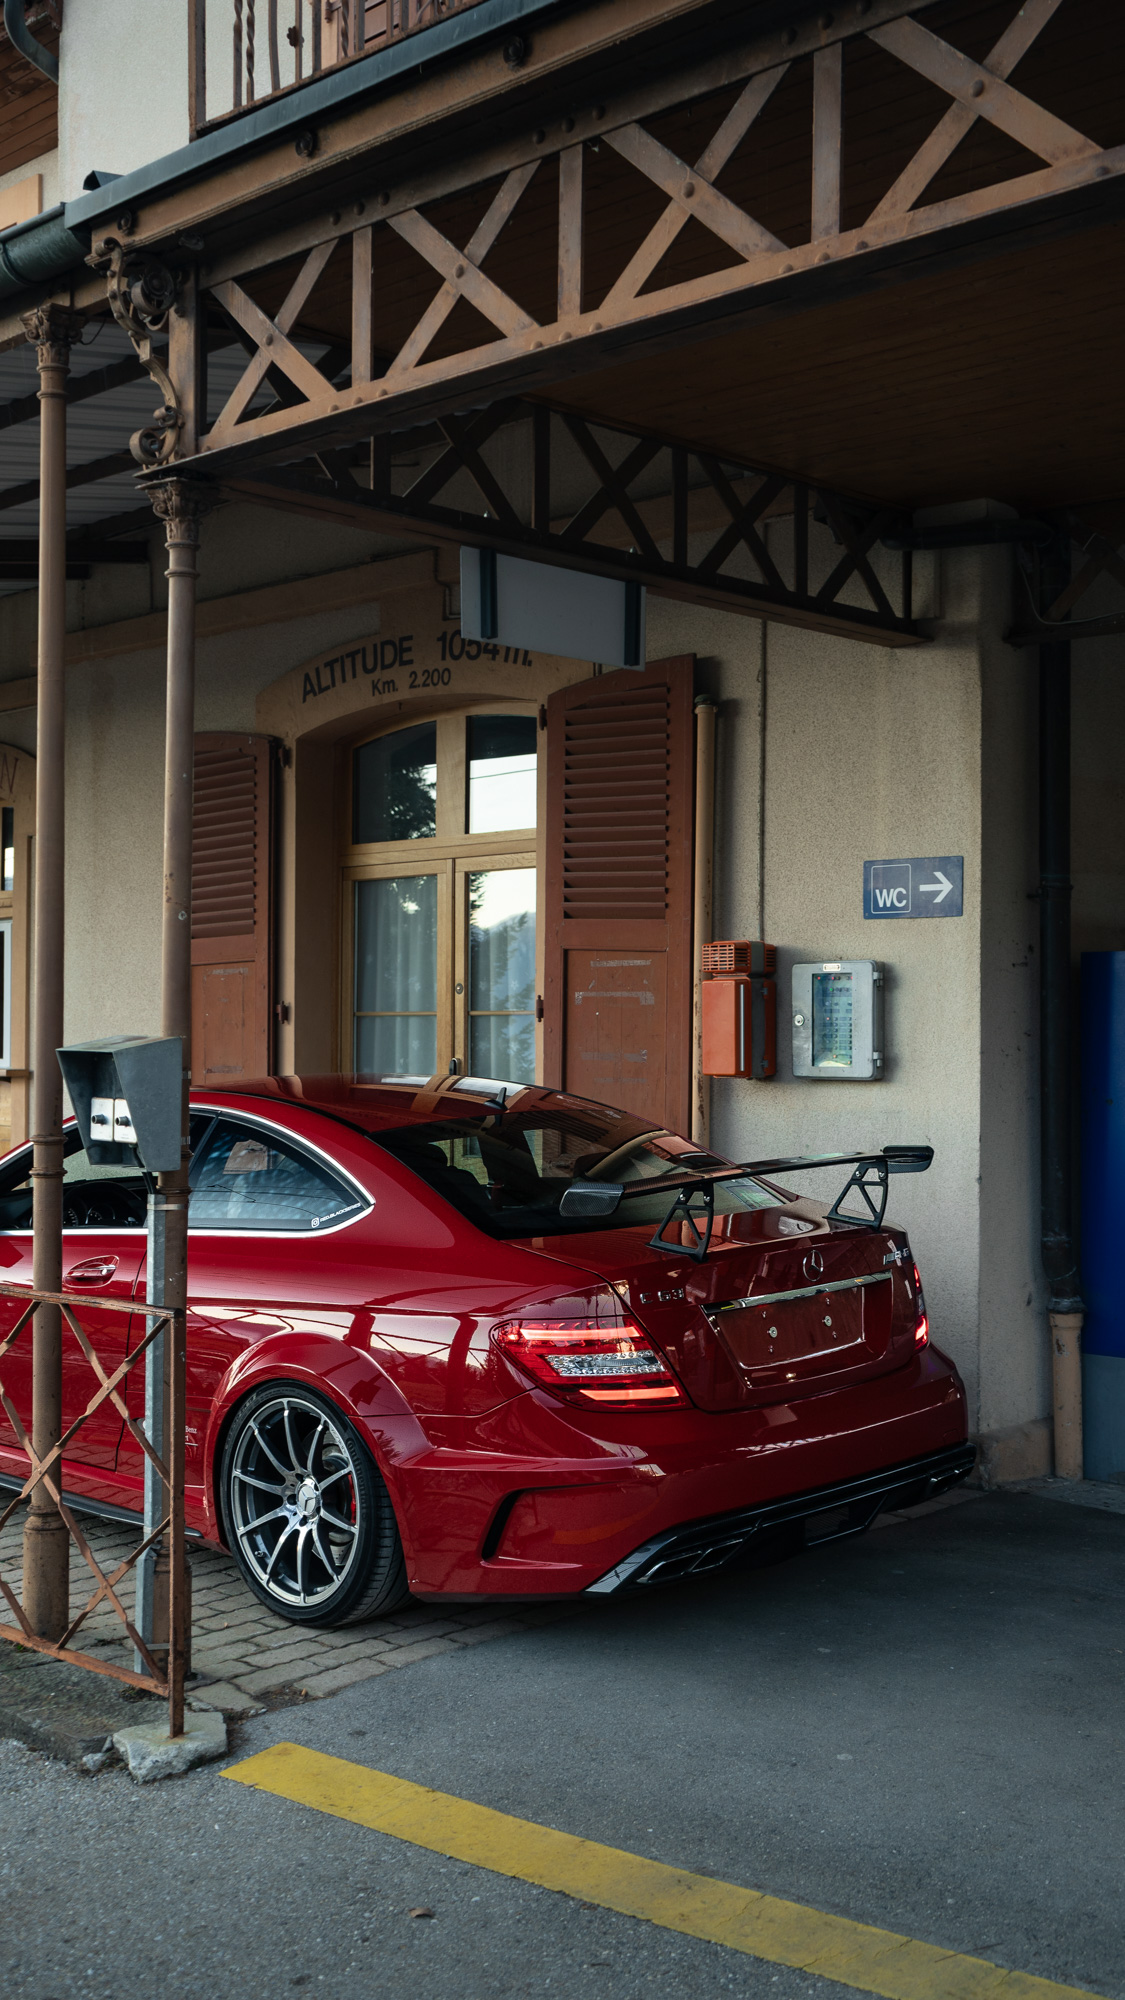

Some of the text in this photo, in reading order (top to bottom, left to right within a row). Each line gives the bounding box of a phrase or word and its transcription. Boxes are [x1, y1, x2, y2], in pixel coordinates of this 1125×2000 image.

[302, 634, 414, 704] ALTITUDE
[436, 629, 500, 662] 1054
[371, 667, 451, 697] Km. 2.200
[875, 887, 907, 908] WC
[639, 1288, 685, 1304] C 63
